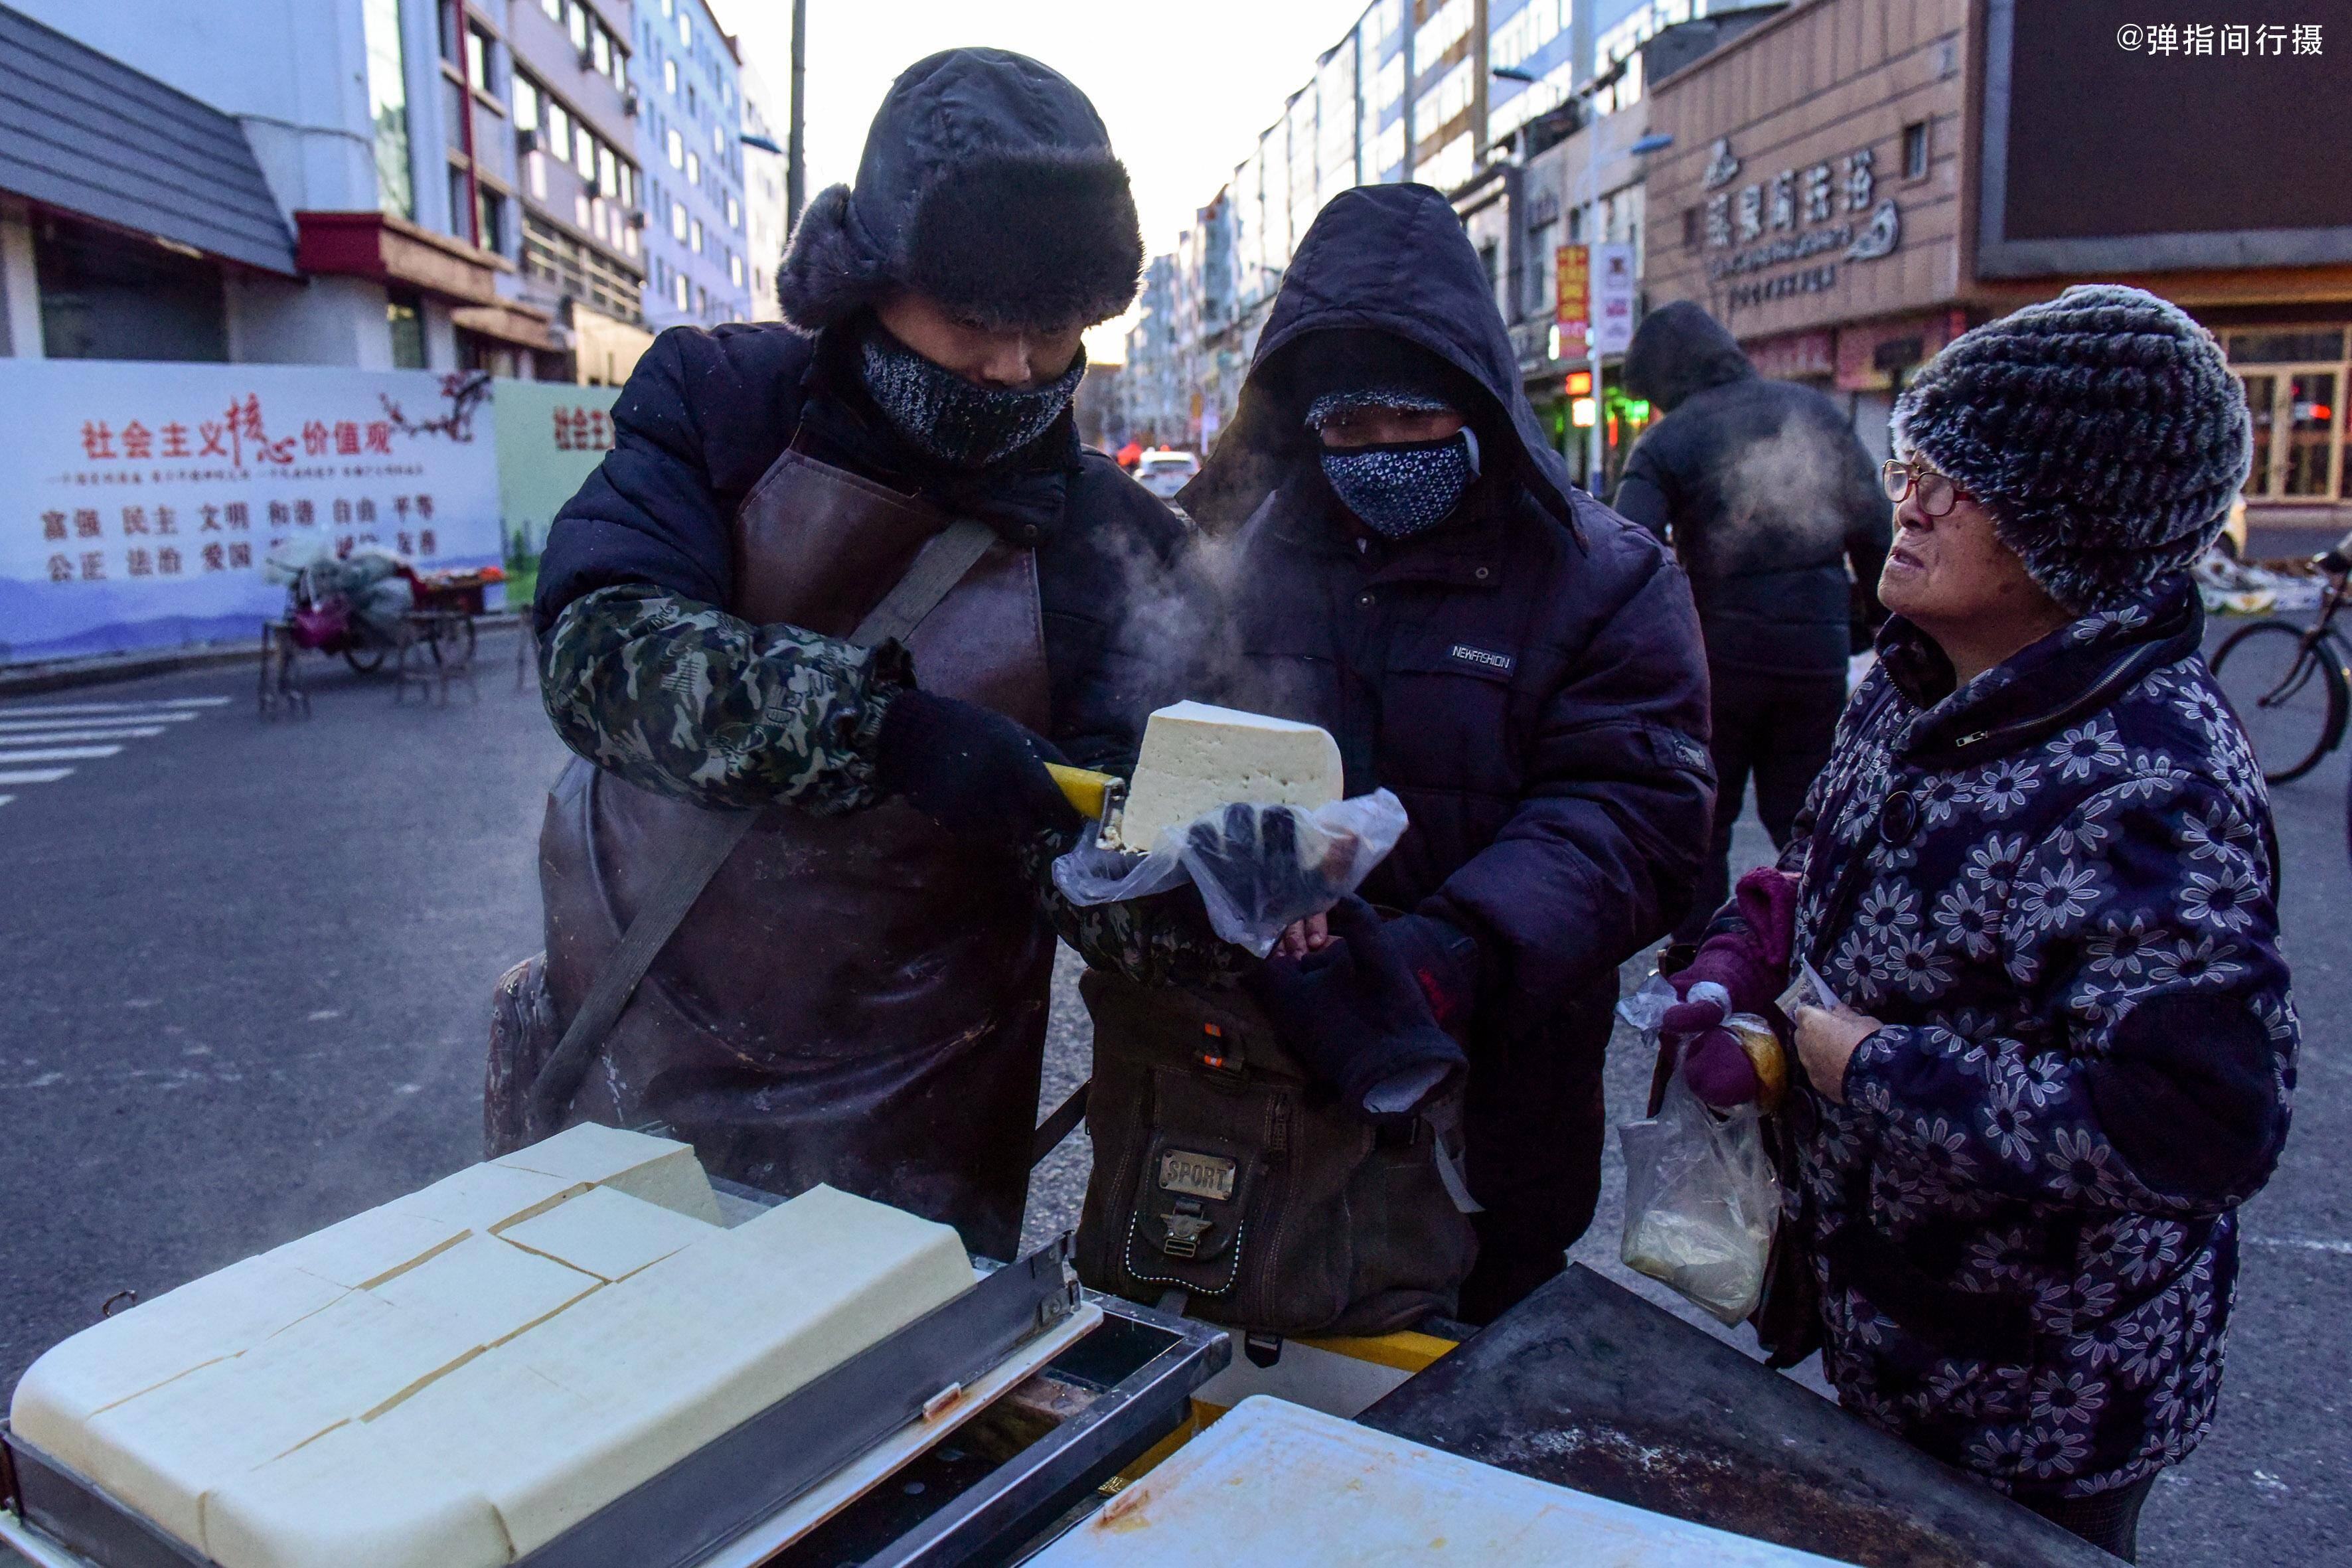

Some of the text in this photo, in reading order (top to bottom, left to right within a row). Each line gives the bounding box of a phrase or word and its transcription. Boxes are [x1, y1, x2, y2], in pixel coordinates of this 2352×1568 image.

[554, 406, 615, 451] 社会主
[1167, 1160, 1227, 1191] SPORT
